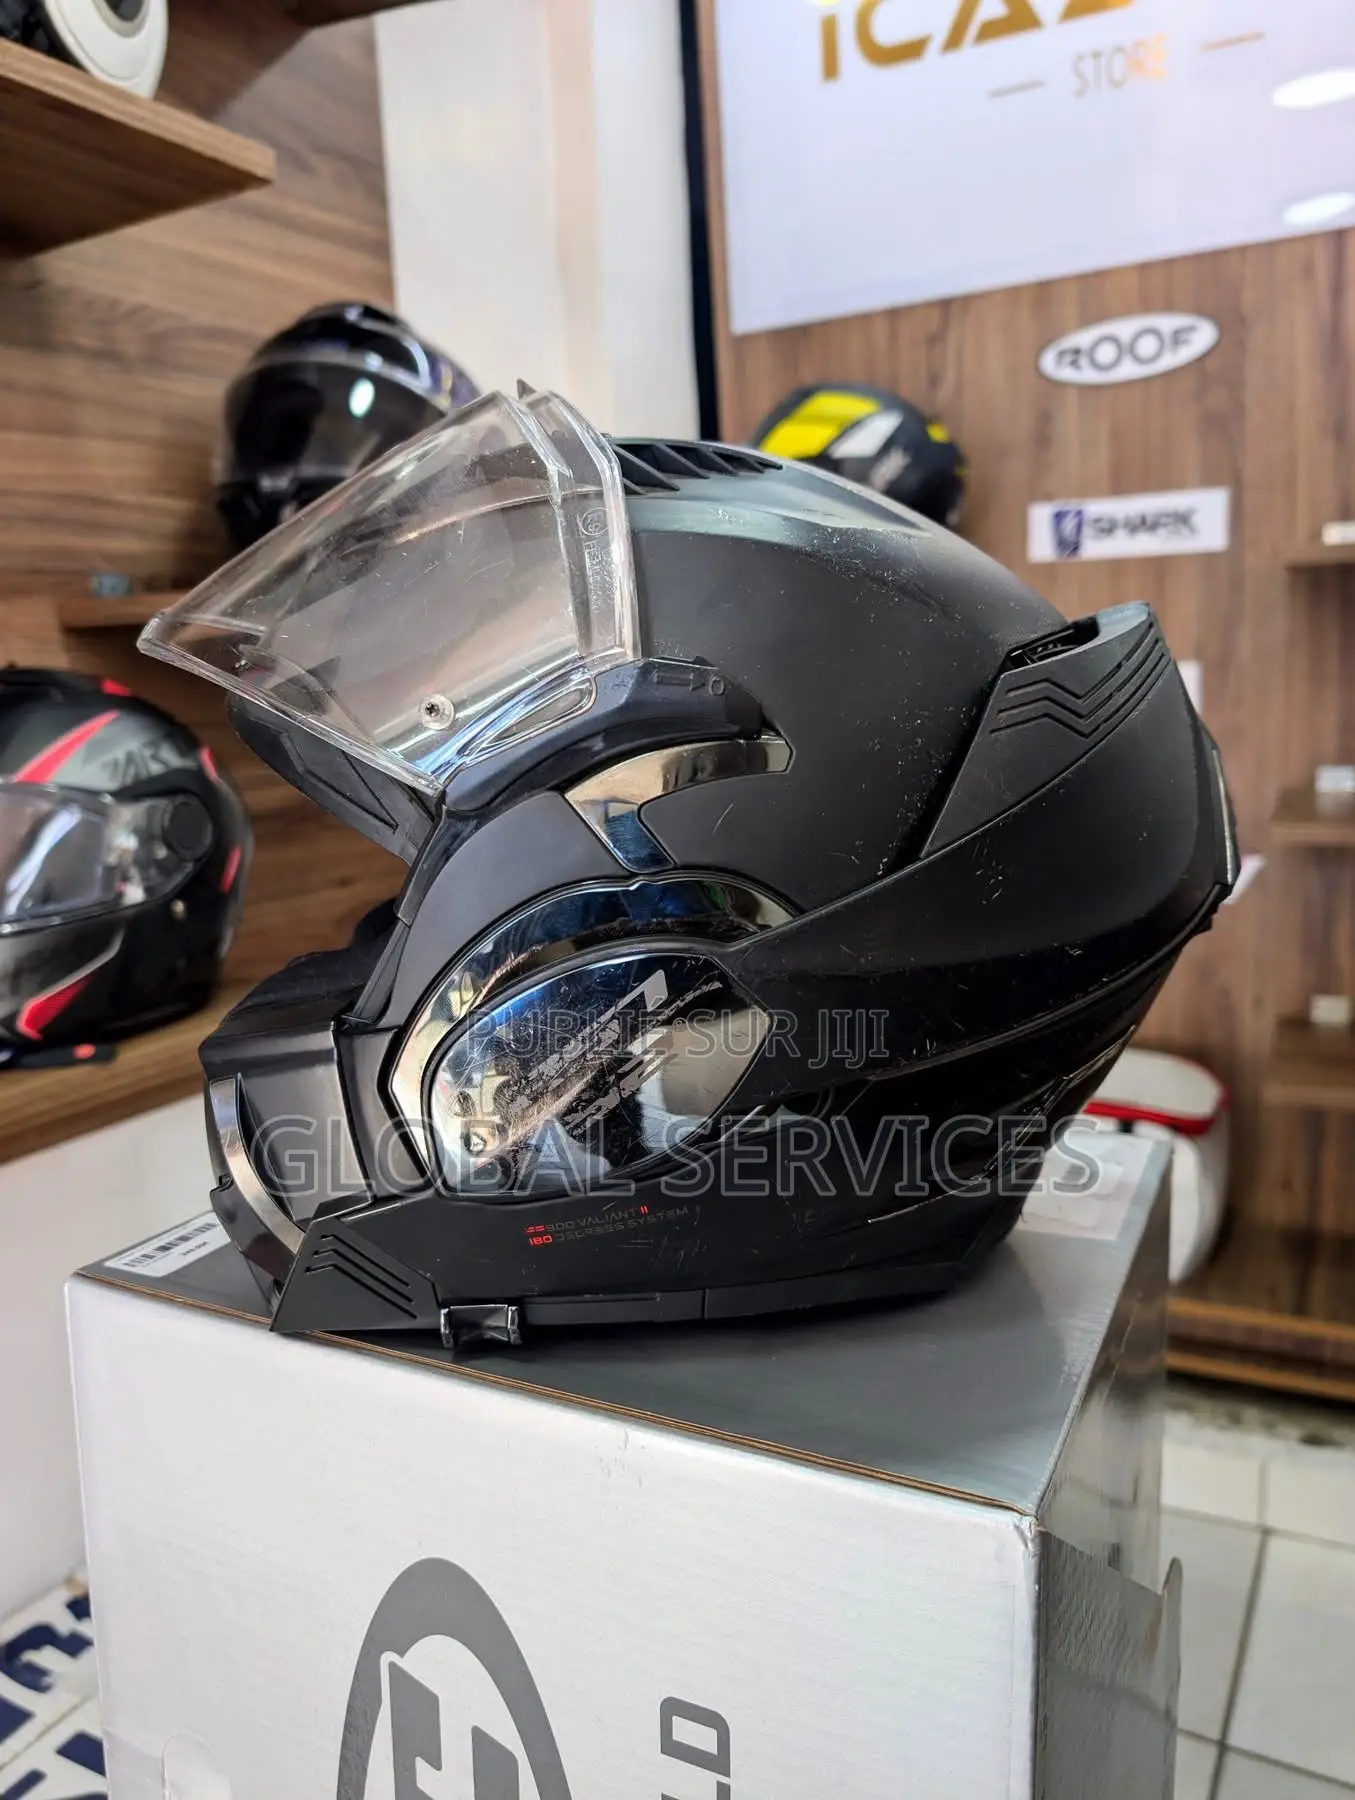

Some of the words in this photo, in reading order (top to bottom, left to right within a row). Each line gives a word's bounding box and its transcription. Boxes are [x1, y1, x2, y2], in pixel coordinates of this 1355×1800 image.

[1073, 33, 1168, 98] STORE
[1055, 323, 1198, 371] ROOF
[529, 1234, 553, 1247] 180
[556, 1223, 625, 1241] DEGREES
[628, 1206, 688, 1229] SYSTEM
[577, 1207, 638, 1227] VALIANT
